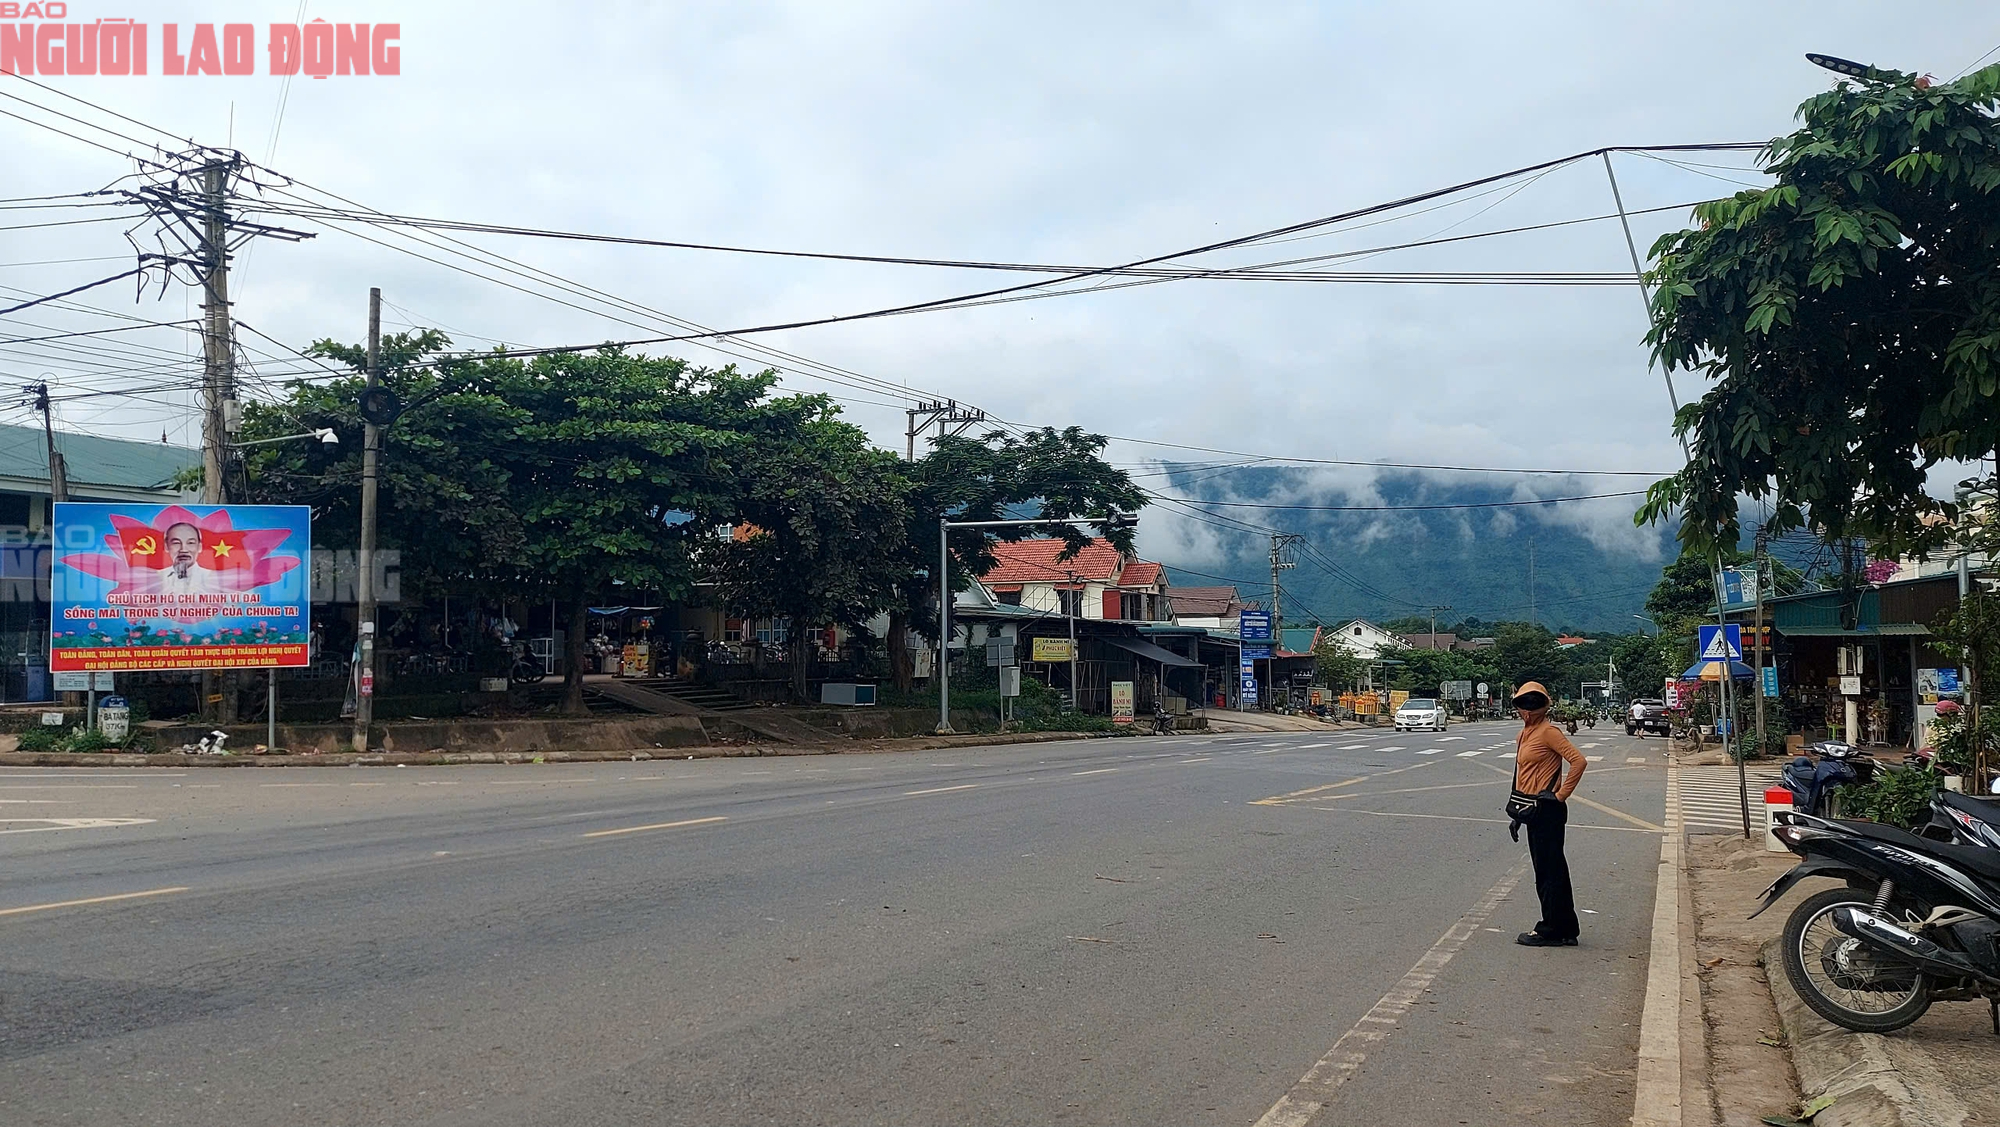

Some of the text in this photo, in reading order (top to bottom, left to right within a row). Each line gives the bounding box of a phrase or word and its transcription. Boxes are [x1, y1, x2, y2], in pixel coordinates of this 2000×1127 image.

[107, 592, 131, 604] CHỦ
[132, 594, 156, 605] TỊCH
[178, 591, 195, 603] CHÍ
[199, 593, 227, 603] MINH
[243, 593, 260, 604] ĐẠI
[64, 605, 95, 619] SỐNG
[123, 608, 159, 618] TRONG
[162, 606, 178, 619] SỰ
[180, 606, 219, 618] NGHIỆP
[222, 605, 243, 617] CỦA
[284, 606, 299, 616] TA!
